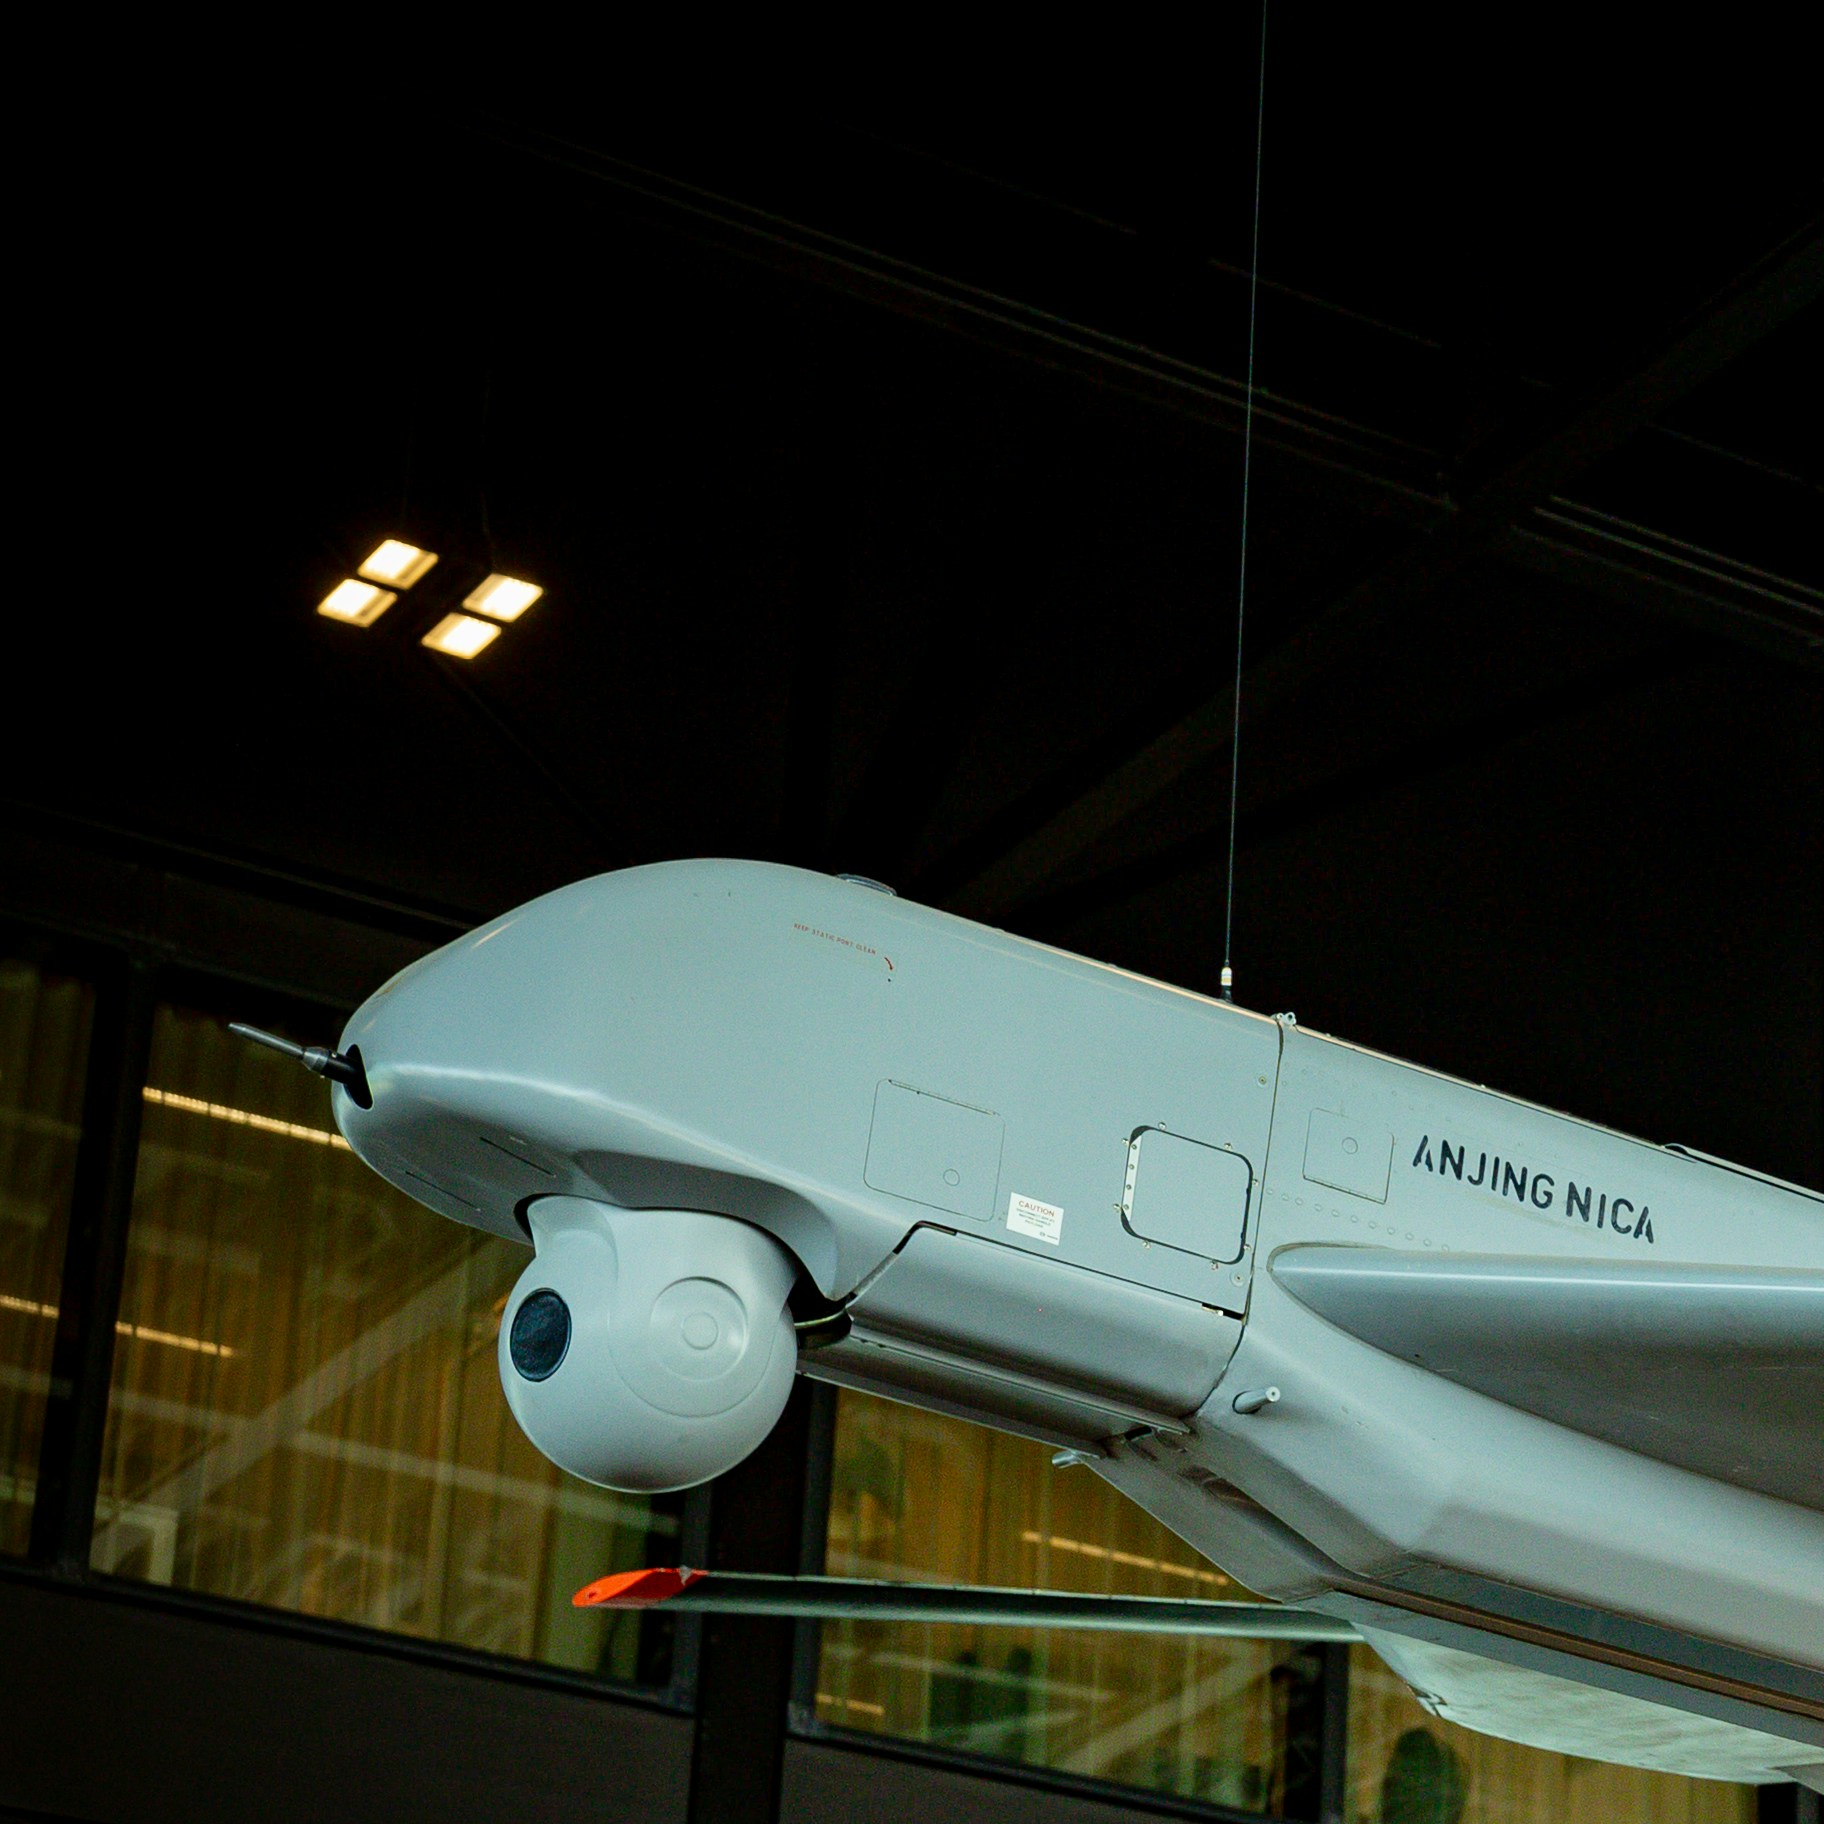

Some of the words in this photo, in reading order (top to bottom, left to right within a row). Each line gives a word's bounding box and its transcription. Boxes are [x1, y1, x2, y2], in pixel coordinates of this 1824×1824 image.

[1018, 1200, 1055, 1217] CAUTION
[1412, 1134, 1554, 1210] ANJING
[1565, 1180, 1655, 1244] NICA
